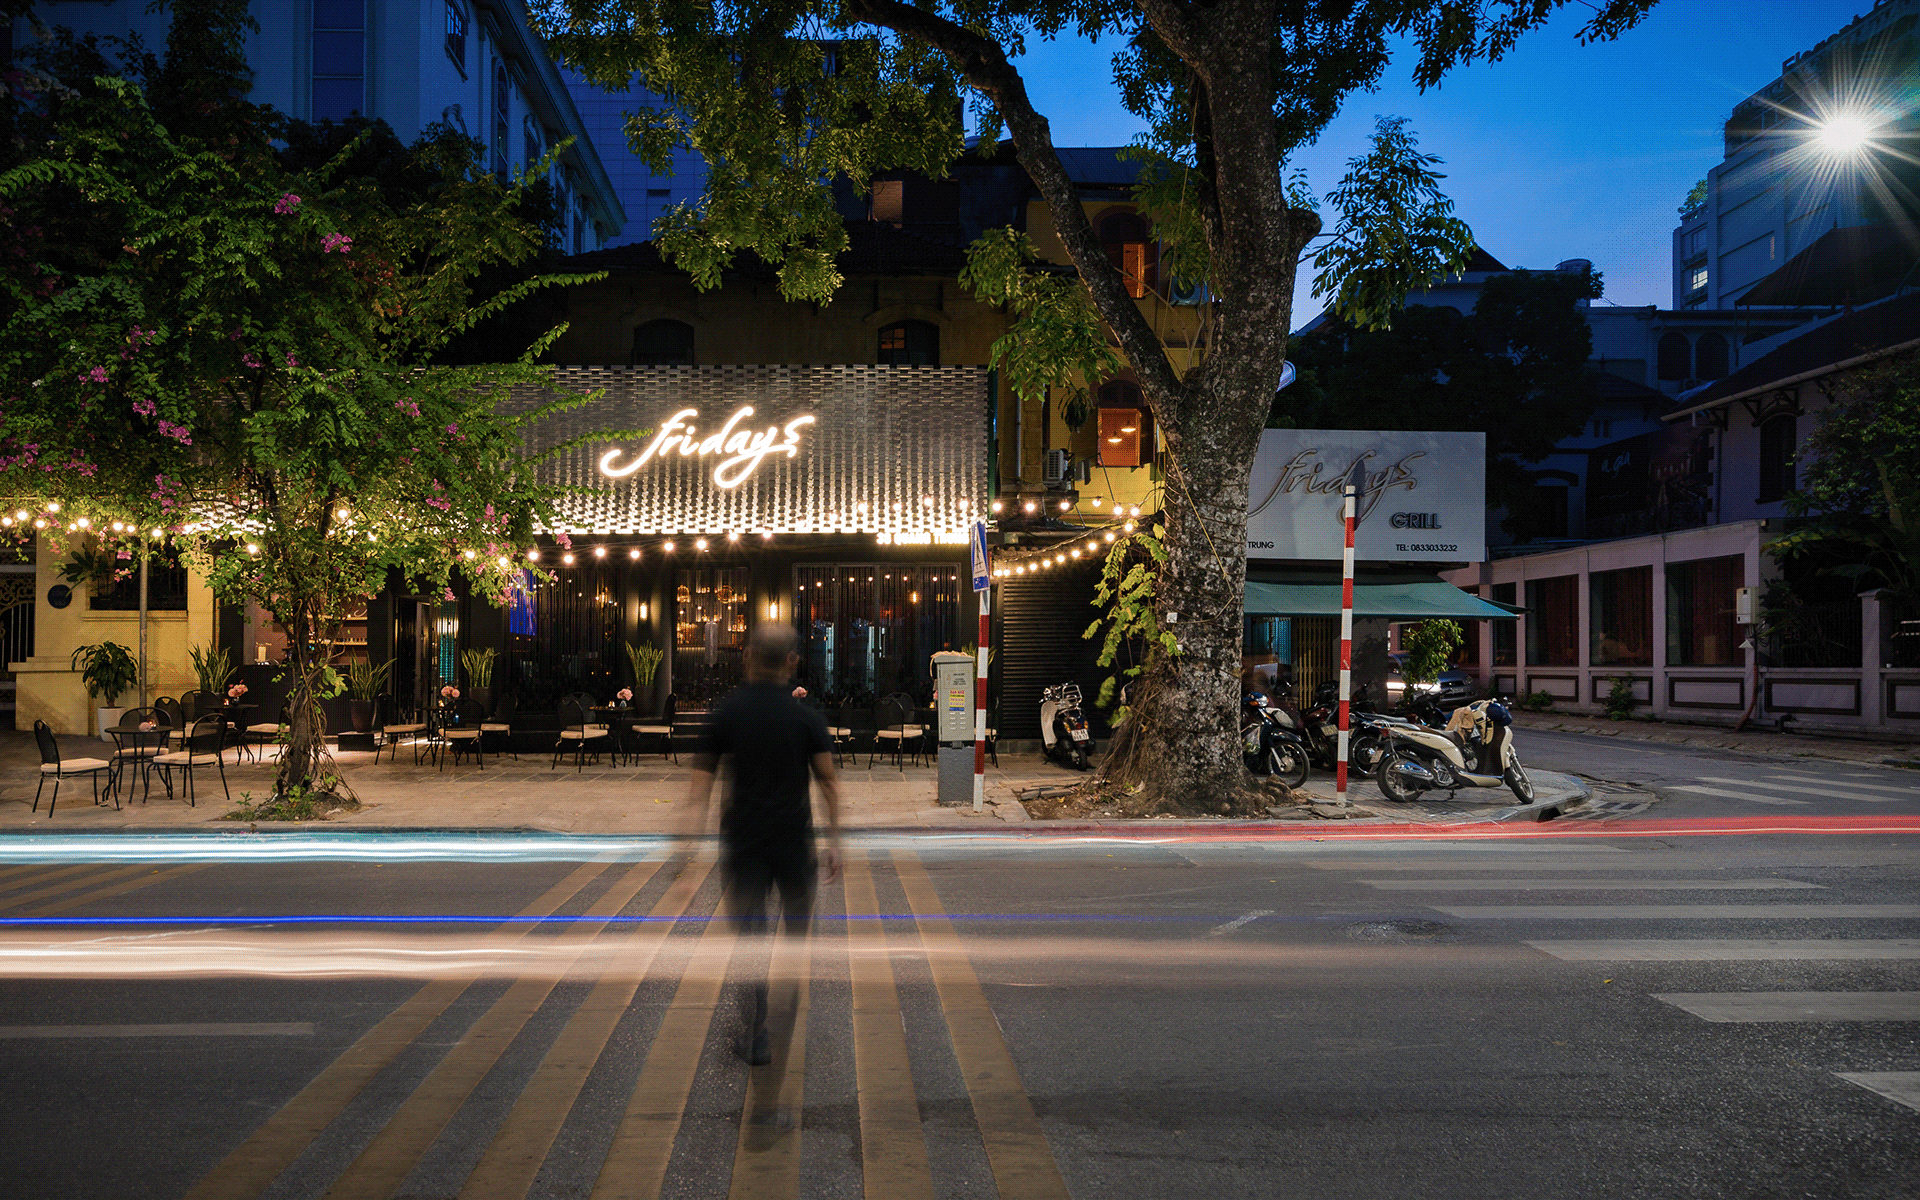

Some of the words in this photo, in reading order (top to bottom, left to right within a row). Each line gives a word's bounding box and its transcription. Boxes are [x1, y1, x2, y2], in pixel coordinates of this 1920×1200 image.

[600, 407, 815, 489] fridays
[1391, 512, 1442, 529] GRILL
[1247, 541, 1275, 549] TRUNG
[1395, 544, 1410, 552] TEL:
[1410, 544, 1458, 552] 0833033232
